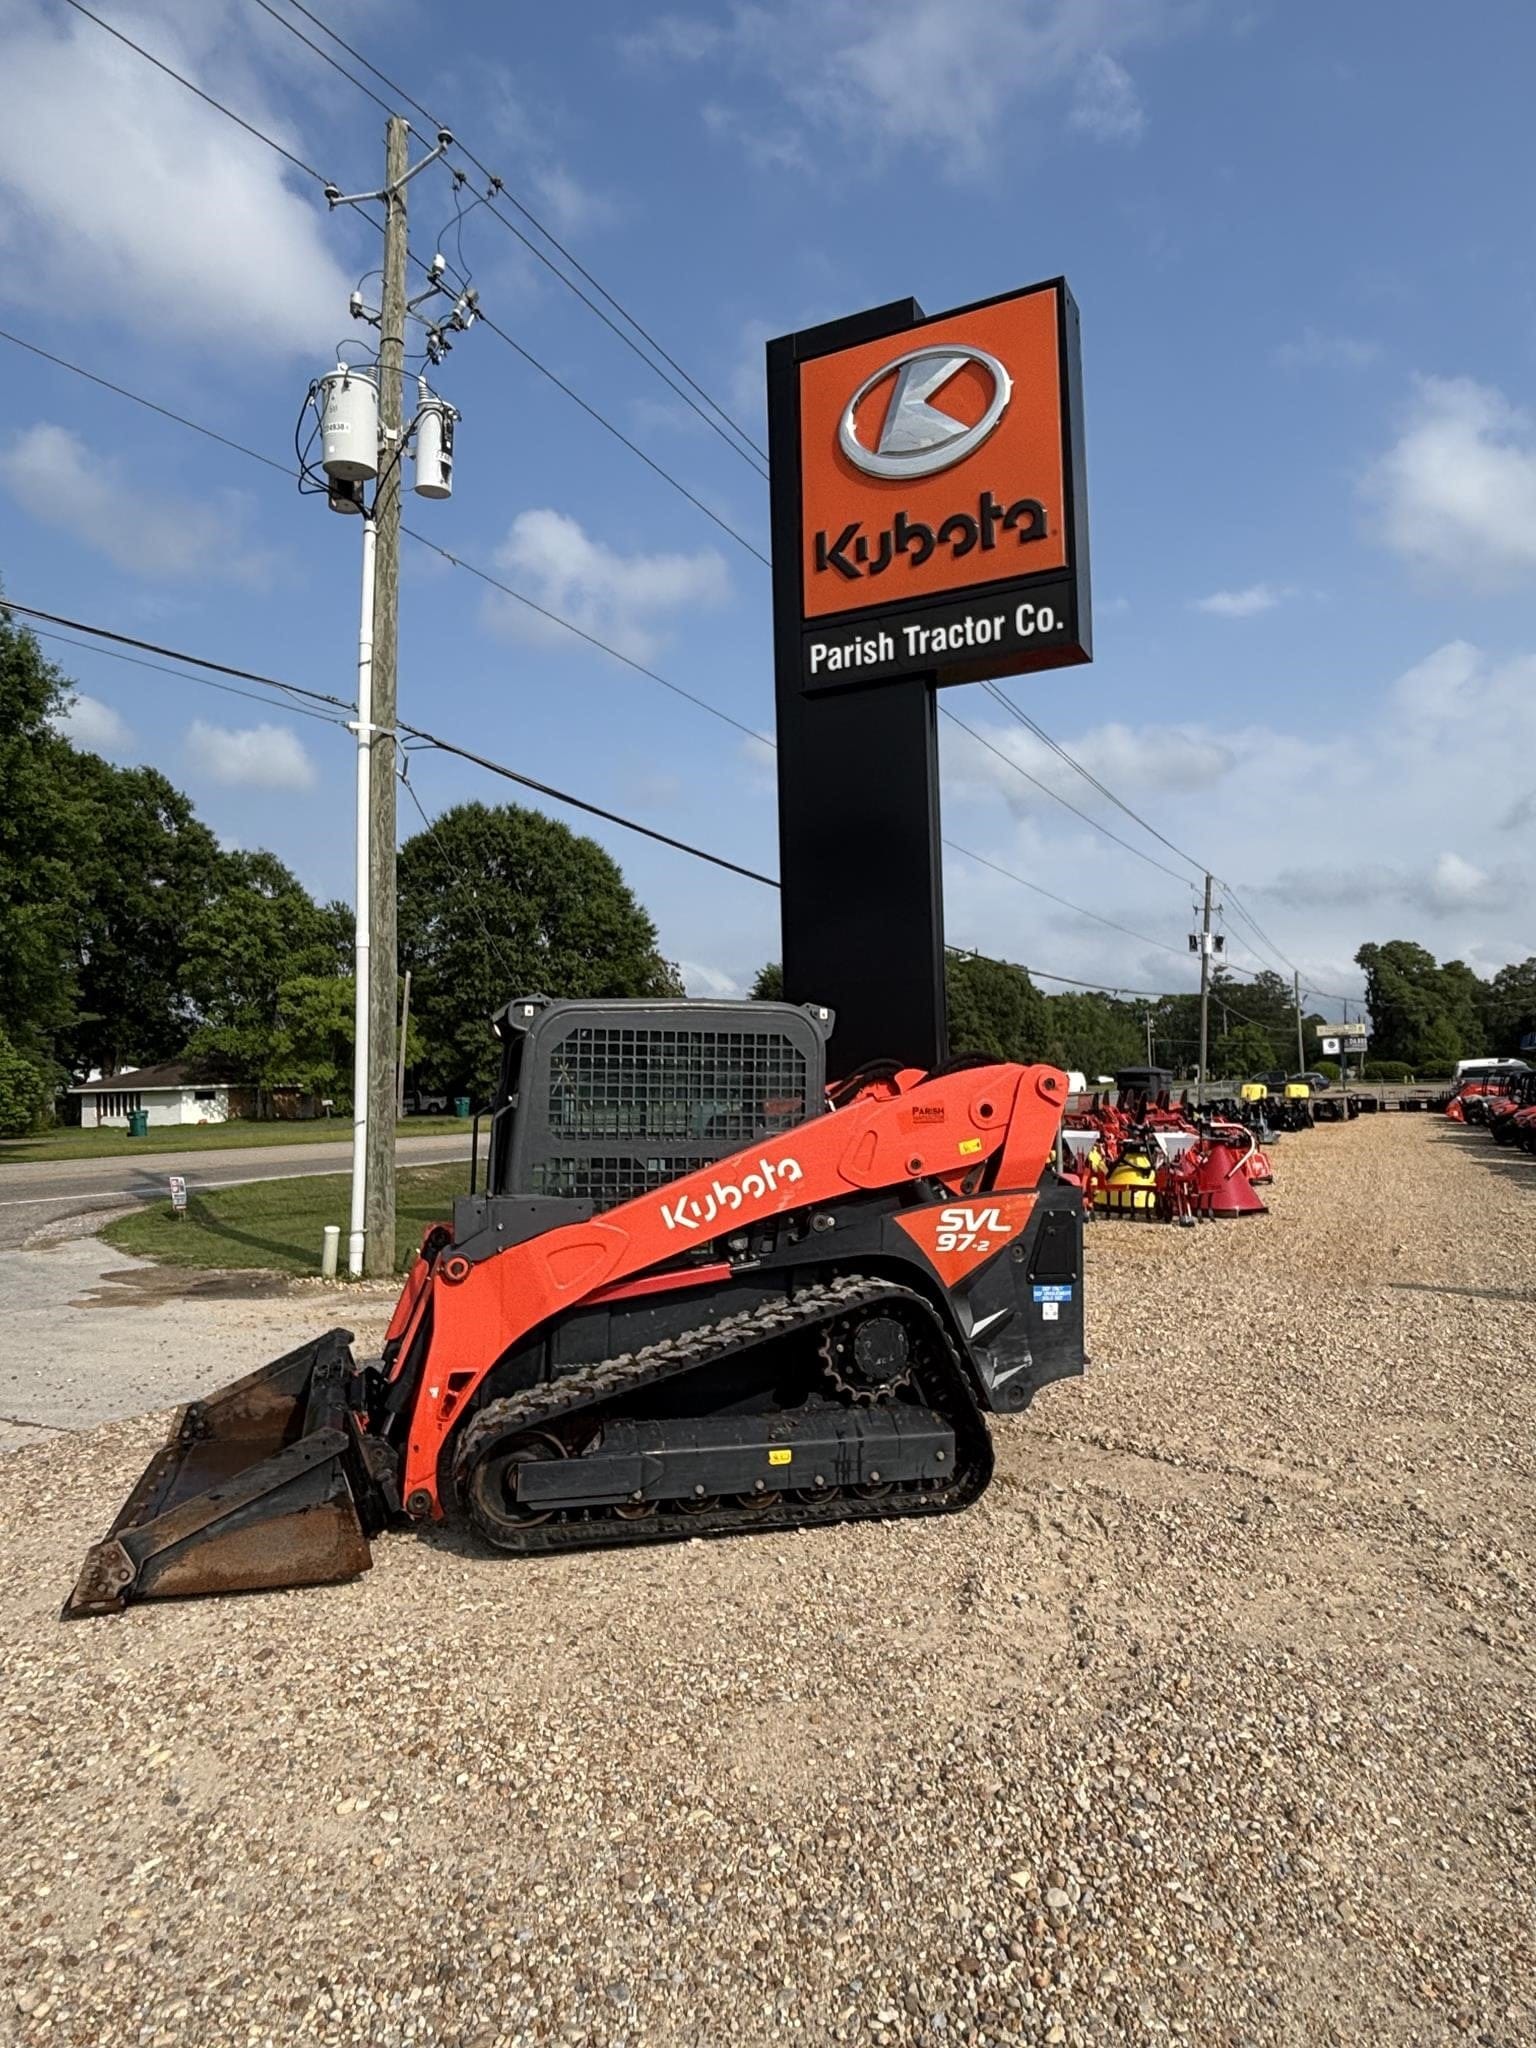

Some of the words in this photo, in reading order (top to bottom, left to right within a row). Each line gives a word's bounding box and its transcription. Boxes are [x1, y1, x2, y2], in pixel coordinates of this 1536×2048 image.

[815, 490, 1048, 580] Kubota
[810, 631, 894, 674] Parish
[903, 614, 1005, 657] Tractor
[1015, 603, 1064, 636] Co.
[660, 1158, 804, 1230] Kubota
[936, 1208, 1012, 1232] SVL
[935, 1233, 990, 1252] 97-2
